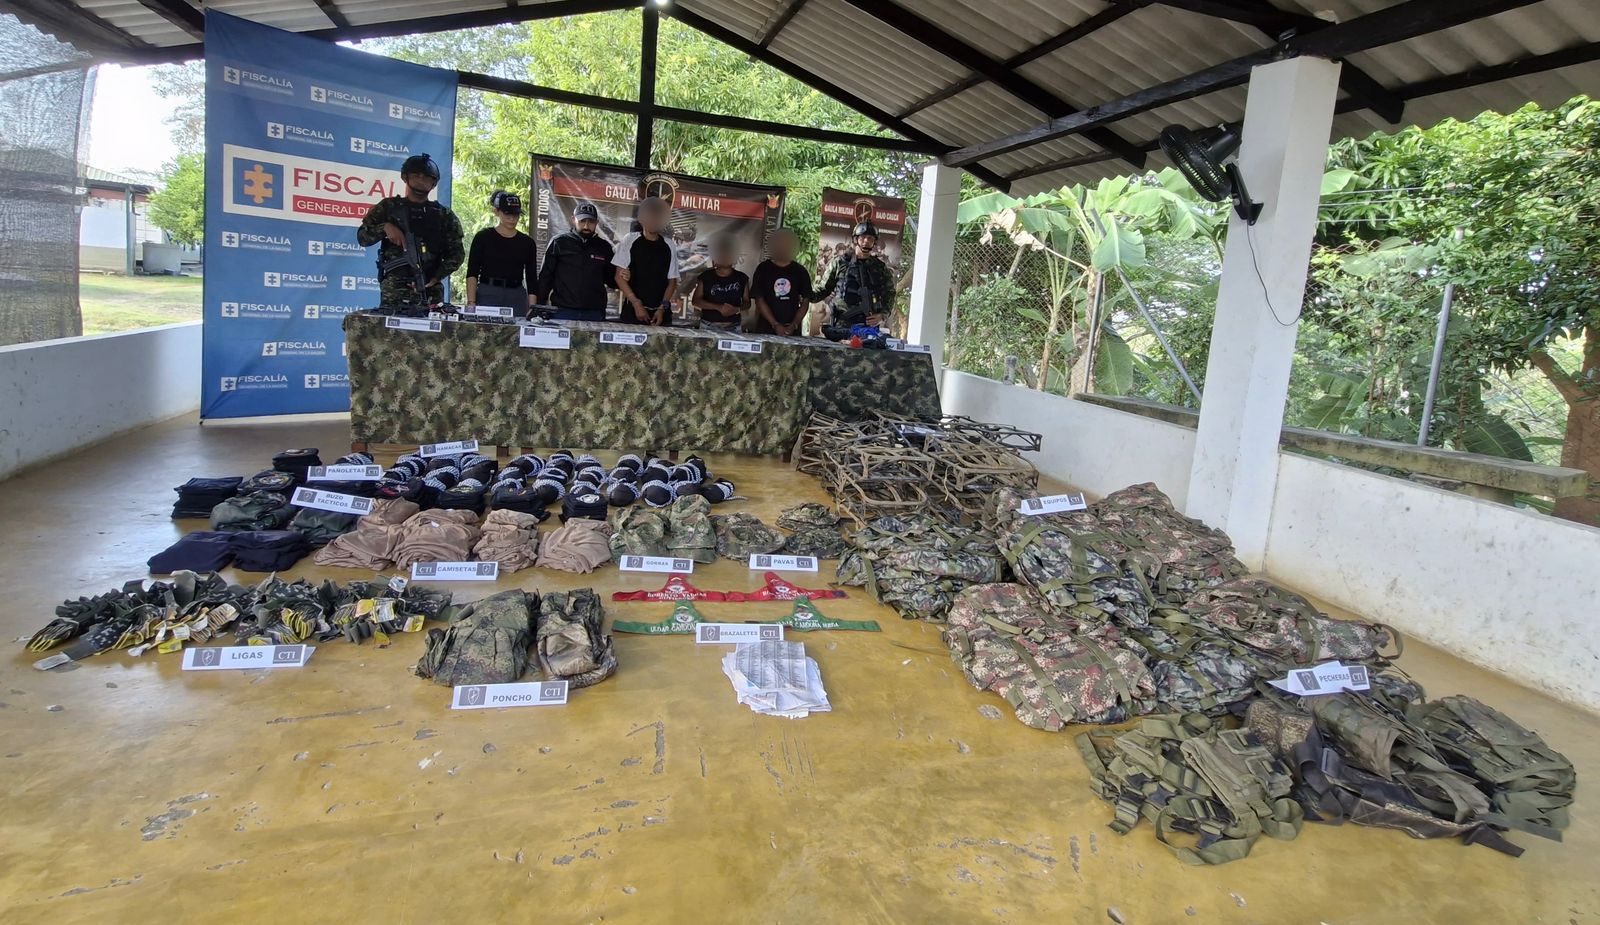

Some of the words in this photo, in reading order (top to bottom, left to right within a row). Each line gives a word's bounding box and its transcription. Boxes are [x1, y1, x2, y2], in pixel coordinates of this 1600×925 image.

[242, 71, 293, 89] FISCALÍA
[327, 89, 374, 106] FISCALÍA
[404, 106, 441, 119] FISCALÍA
[286, 125, 334, 141] FISCALÍA
[366, 139, 409, 153] FISCALÍA
[293, 167, 395, 198] FISCAL
[538, 188, 550, 216] TODOS
[605, 185, 639, 200] GAULA
[681, 195, 720, 211] MILITAR
[296, 200, 355, 215] GENERAL
[537, 218, 548, 229] DE
[240, 233, 291, 246] FISCALÍA
[282, 273, 328, 283] FISCALÍA
[357, 277, 380, 285] FISC
[241, 303, 291, 313] FISCALÍA
[278, 341, 326, 350] FISCALÍA
[237, 374, 288, 383] FISCALÍA
[326, 493, 344, 501] BUZO
[1043, 497, 1067, 505] EQUIPOS
[317, 498, 349, 508] TACTICOS
[762, 629, 776, 637] CTI
[231, 651, 263, 660] LIGAS
[278, 650, 296, 660] CTI
[1319, 673, 1350, 682] PECHERAS
[1351, 672, 1364, 681] CTI
[492, 694, 532, 703] PONCHO
[544, 687, 561, 697] CTI
